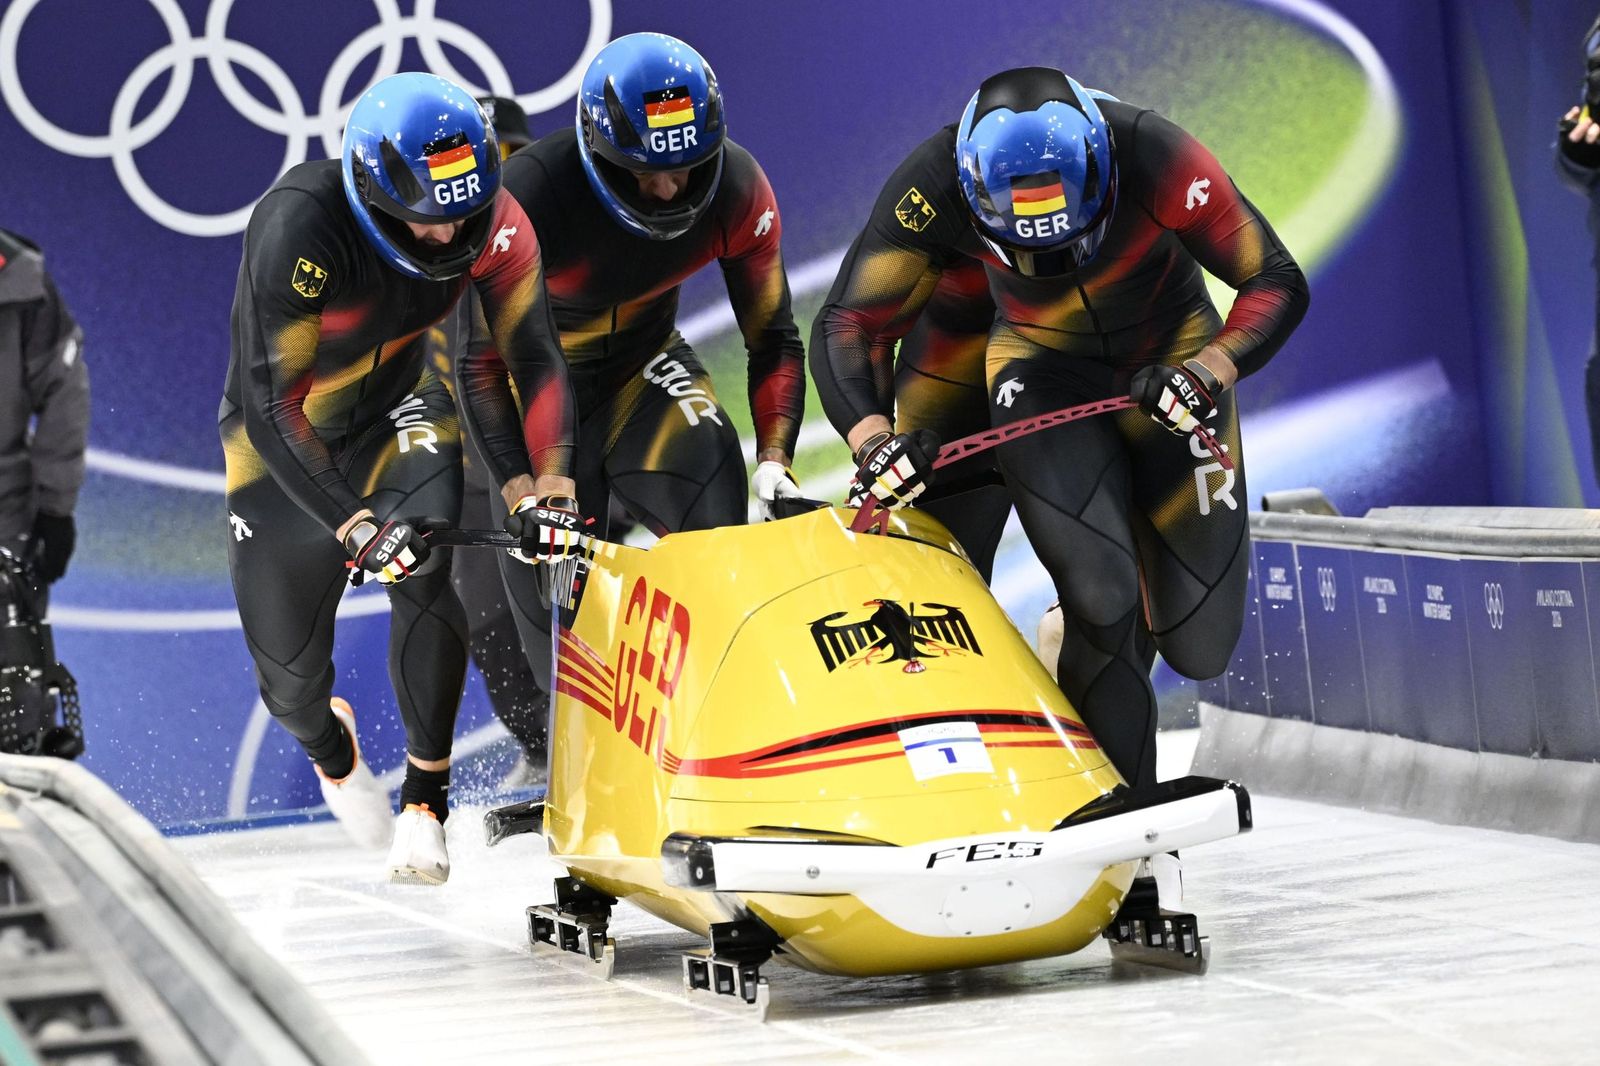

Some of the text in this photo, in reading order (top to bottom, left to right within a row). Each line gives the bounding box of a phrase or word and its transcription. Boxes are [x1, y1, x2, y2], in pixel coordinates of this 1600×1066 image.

[649, 125, 698, 153] GER
[433, 173, 481, 205] GER
[1015, 213, 1071, 238] GER
[1171, 373, 1201, 410] SEIZ
[869, 439, 902, 475] SEIZ
[536, 509, 577, 529] SEIZ
[376, 526, 407, 563] SEIZ
[938, 747, 958, 764] 1
[926, 841, 1044, 869] FES
